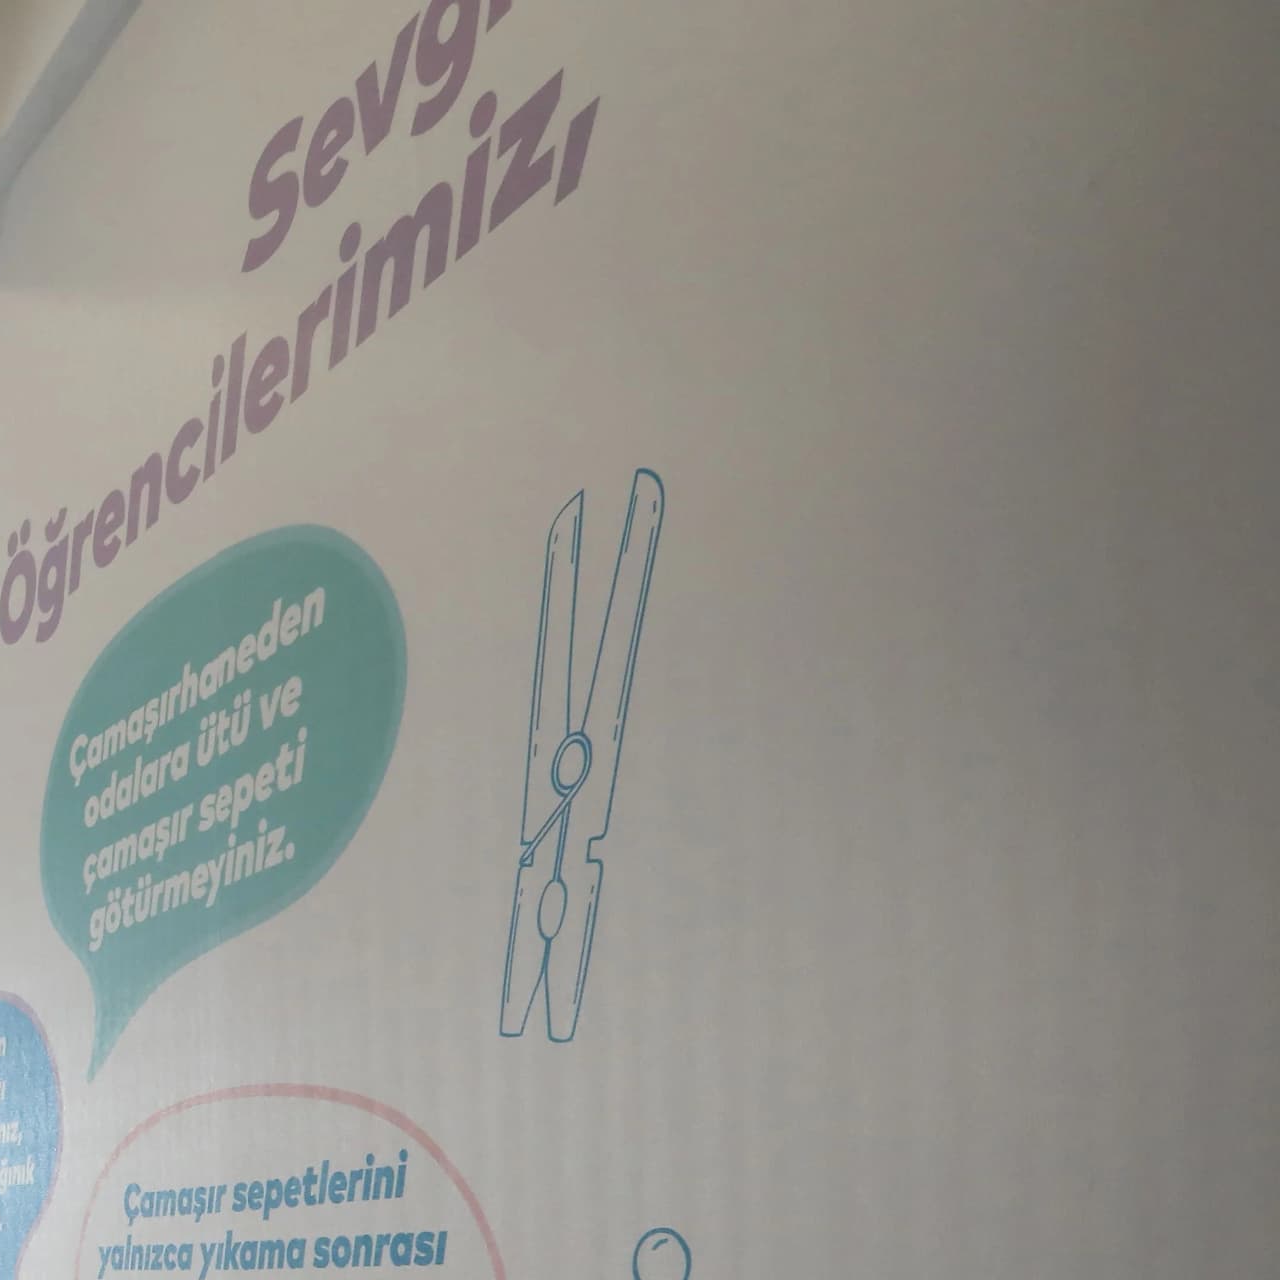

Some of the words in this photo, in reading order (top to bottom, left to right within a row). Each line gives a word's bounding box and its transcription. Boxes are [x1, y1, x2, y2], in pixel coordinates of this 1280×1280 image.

[69, 586, 327, 787] Çamaşırhaneden
[83, 741, 191, 828] odalara
[196, 688, 252, 767] ütü
[258, 675, 303, 730] ve
[83, 802, 194, 895] çamaşır
[198, 726, 308, 830] sepeti
[88, 816, 297, 952] götürmeyiniz.
[97, 1235, 194, 1280] yalnızca
[198, 1230, 307, 1280] yıkama
[312, 1230, 449, 1270] sonrası
[123, 1183, 228, 1226] Çamaşır
[231, 1148, 409, 1220] sepetlerini
